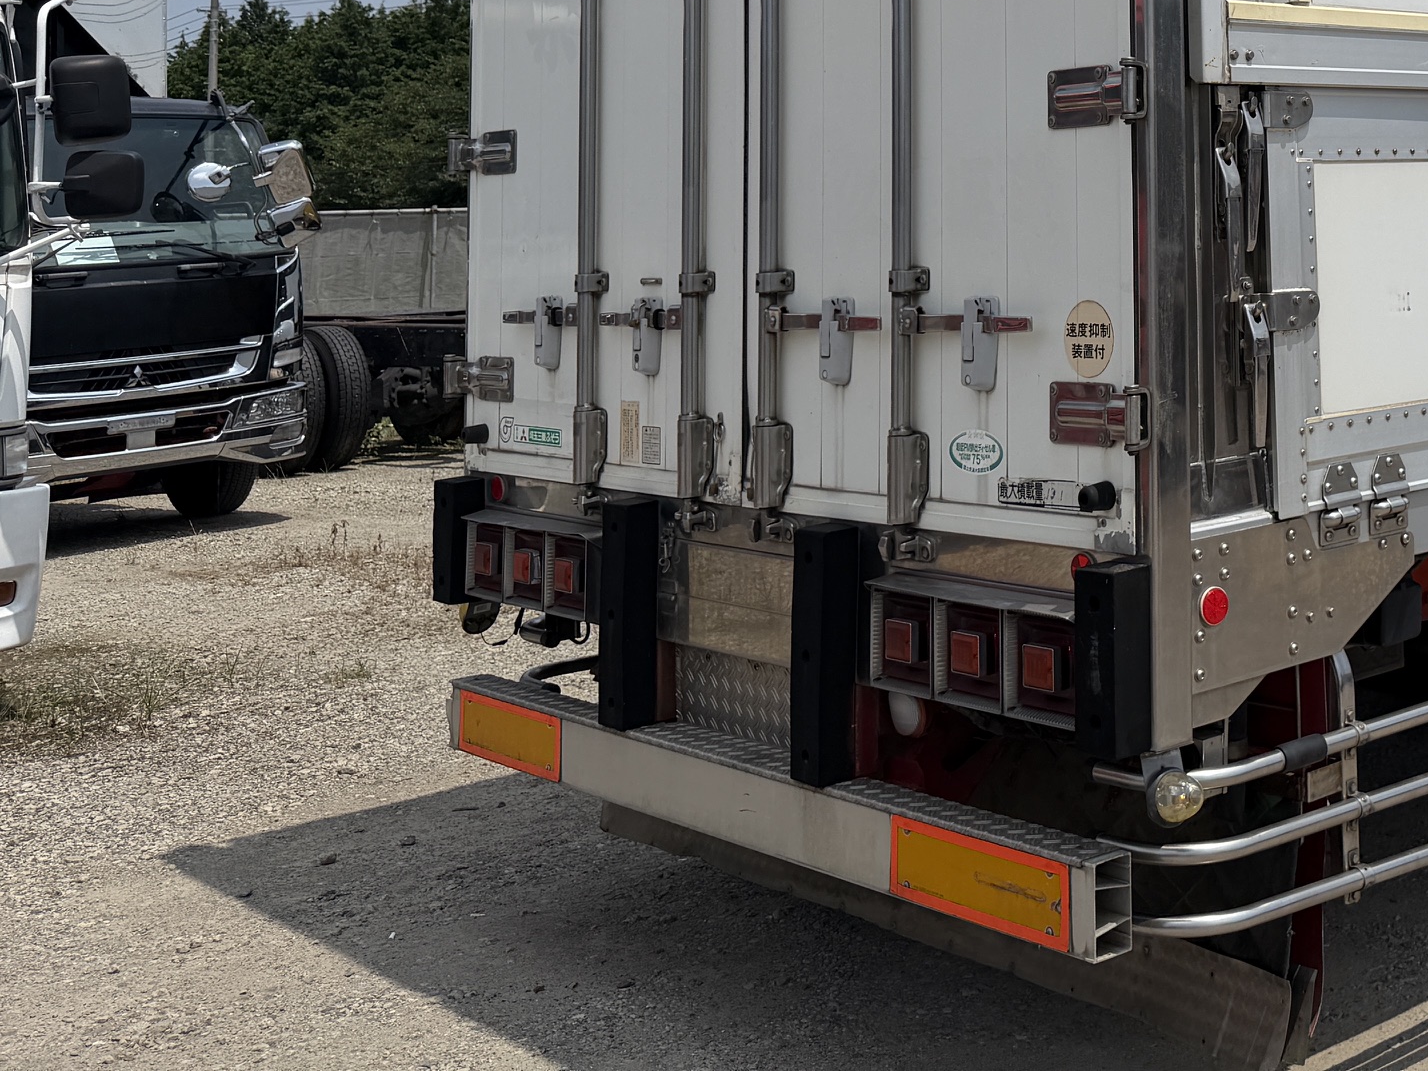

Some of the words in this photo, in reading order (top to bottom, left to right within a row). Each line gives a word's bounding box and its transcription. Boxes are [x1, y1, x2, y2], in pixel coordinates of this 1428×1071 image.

[1066, 322, 1111, 339] 速度抑制
[1071, 343, 1105, 360] 装置付
[1000, 482, 1044, 501] 最大積載量
